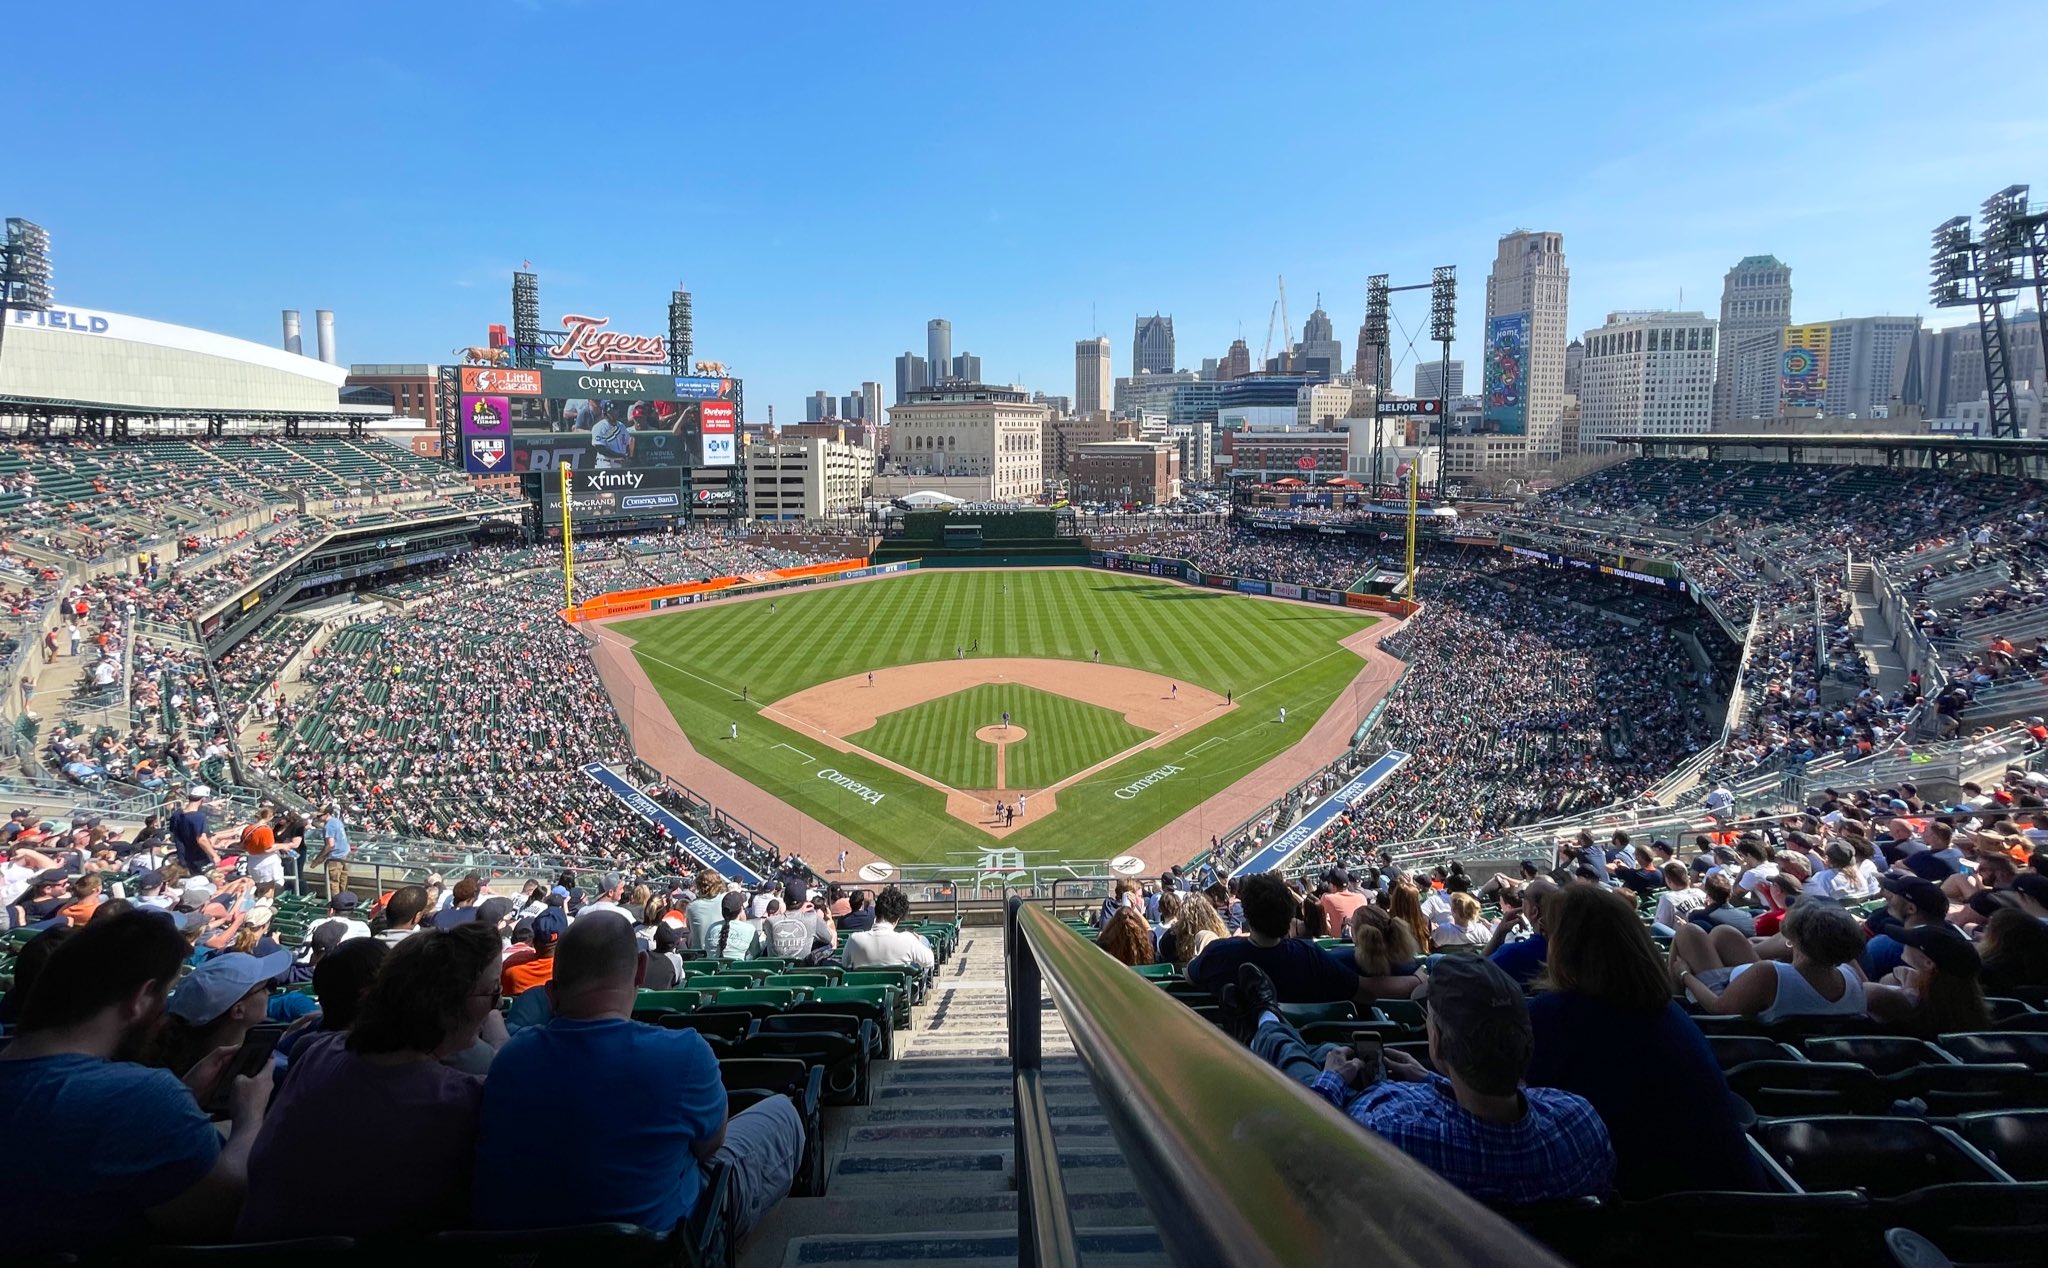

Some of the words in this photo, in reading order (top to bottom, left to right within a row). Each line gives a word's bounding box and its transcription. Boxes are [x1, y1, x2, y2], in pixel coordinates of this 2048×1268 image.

[14, 309, 109, 334] FIELD
[549, 314, 667, 369] Tigers
[506, 370, 534, 383] Little
[498, 379, 538, 392] Caesars
[578, 376, 646, 392] Comerica
[1378, 403, 1418, 412] BELFOR
[473, 413, 496, 421] planet
[474, 440, 503, 449] MLB
[587, 470, 644, 490] xfinity
[657, 496, 674, 504] Bank
[710, 491, 732, 500] pepsi
[583, 498, 613, 507] GRAND
[958, 502, 1021, 510] CHEVROLET
[1600, 565, 1613, 575] TASTE
[1613, 568, 1624, 577] YOU
[1624, 571, 1635, 579] CAN
[1634, 572, 1656, 584] DEPEND
[311, 576, 332, 586] DEPEND
[1274, 585, 1298, 595] meijer
[1114, 764, 1186, 799] Comerica
[817, 768, 886, 806] Comerica
[787, 938, 806, 947] LIFE
